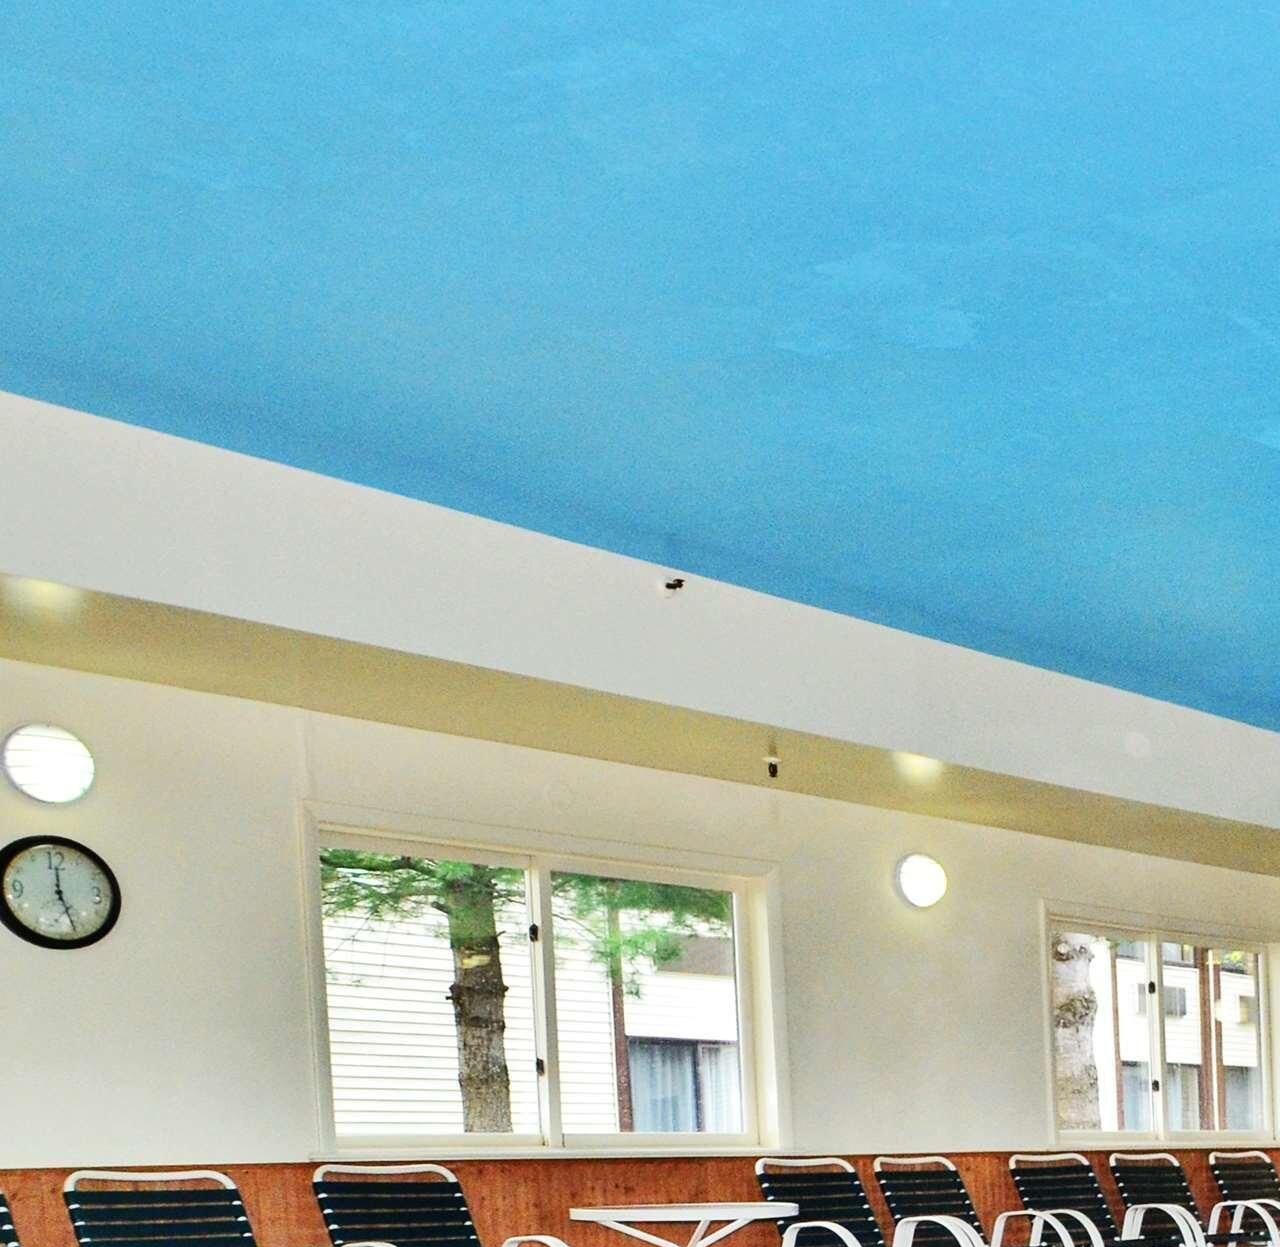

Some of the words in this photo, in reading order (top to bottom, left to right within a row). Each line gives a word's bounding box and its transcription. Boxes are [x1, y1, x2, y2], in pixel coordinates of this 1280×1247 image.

[46, 851, 65, 870] 12
[12, 879, 24, 898] 9
[91, 886, 102, 904] 3
